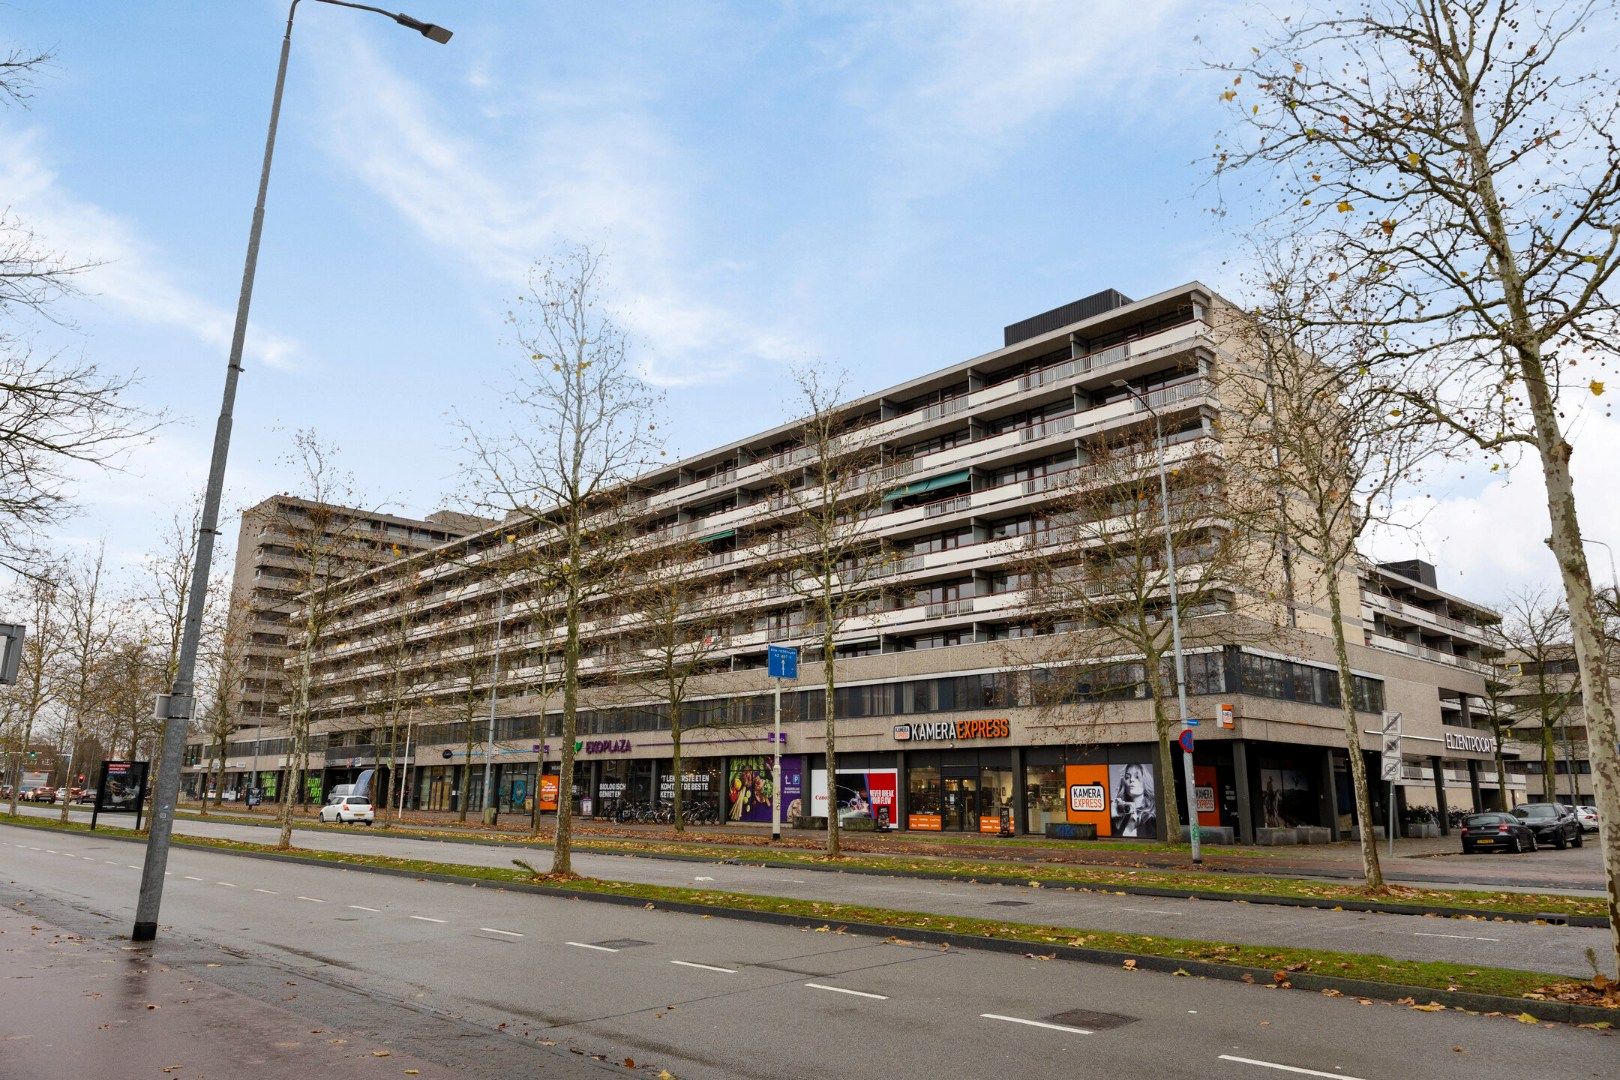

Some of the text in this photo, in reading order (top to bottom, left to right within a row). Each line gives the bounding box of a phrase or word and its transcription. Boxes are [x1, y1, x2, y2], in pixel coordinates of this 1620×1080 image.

[911, 719, 1009, 740] KAMERA EXPRESS
[586, 739, 631, 754] EKOPLAZA
[1445, 733, 1494, 753] ELZENTPOORT
[1073, 788, 1102, 798] KAMERA
[1073, 799, 1102, 808] EXPRESS
